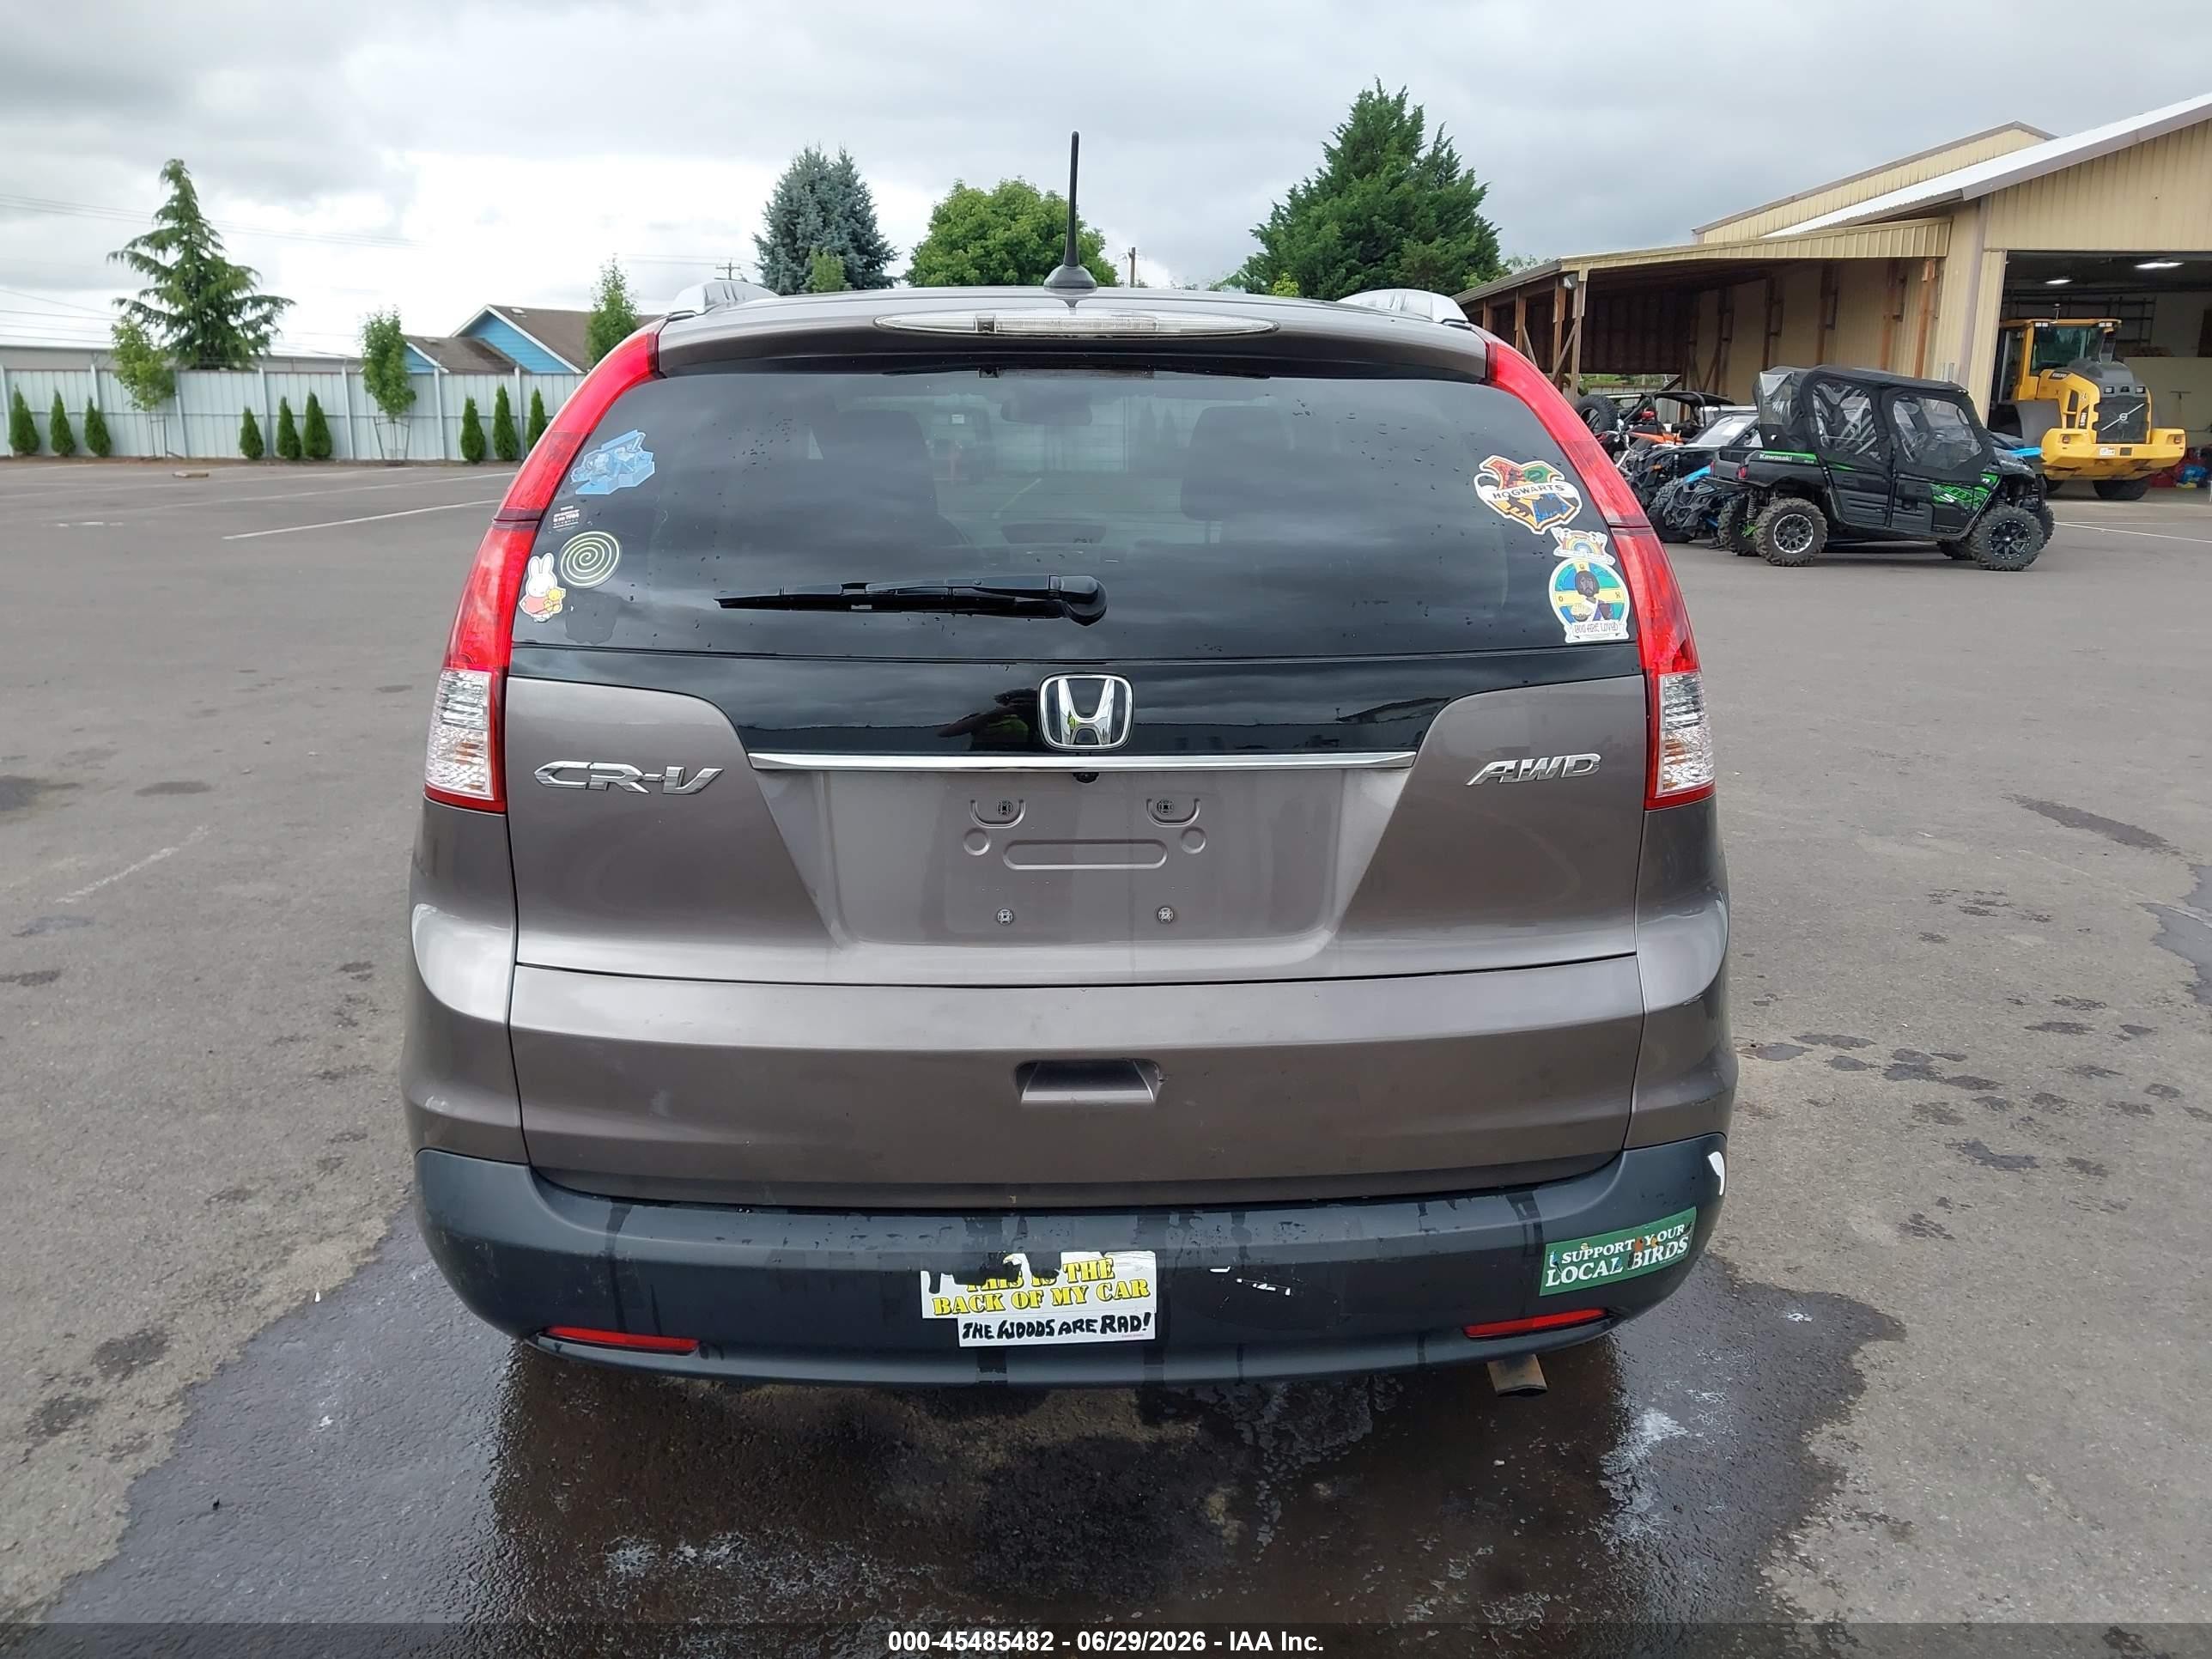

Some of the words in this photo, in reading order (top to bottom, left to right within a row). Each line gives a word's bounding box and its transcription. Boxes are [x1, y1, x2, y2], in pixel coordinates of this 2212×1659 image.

[1759, 453, 1793, 462] Kawasaki
[1492, 484, 1565, 499] HOGWARTS
[534, 761, 724, 795] CR-V
[1464, 752, 1601, 786] AWD
[1546, 1257, 1623, 1287] LOCAL
[1628, 1236, 1689, 1271] BIRDS
[1561, 1239, 1635, 1265] SUPPORT
[1642, 1224, 1686, 1246] YOUR
[1063, 1257, 1115, 1284] THE
[933, 1293, 1006, 1316] BACK
[1011, 1290, 1044, 1310] OF
[1050, 1285, 1089, 1306] MY
[1096, 1279, 1152, 1303] CAR
[962, 1322, 995, 1340] THE
[997, 1319, 1056, 1340] WOODS
[1057, 1318, 1098, 1337] ARE
[1100, 1311, 1152, 1335] RAD!
